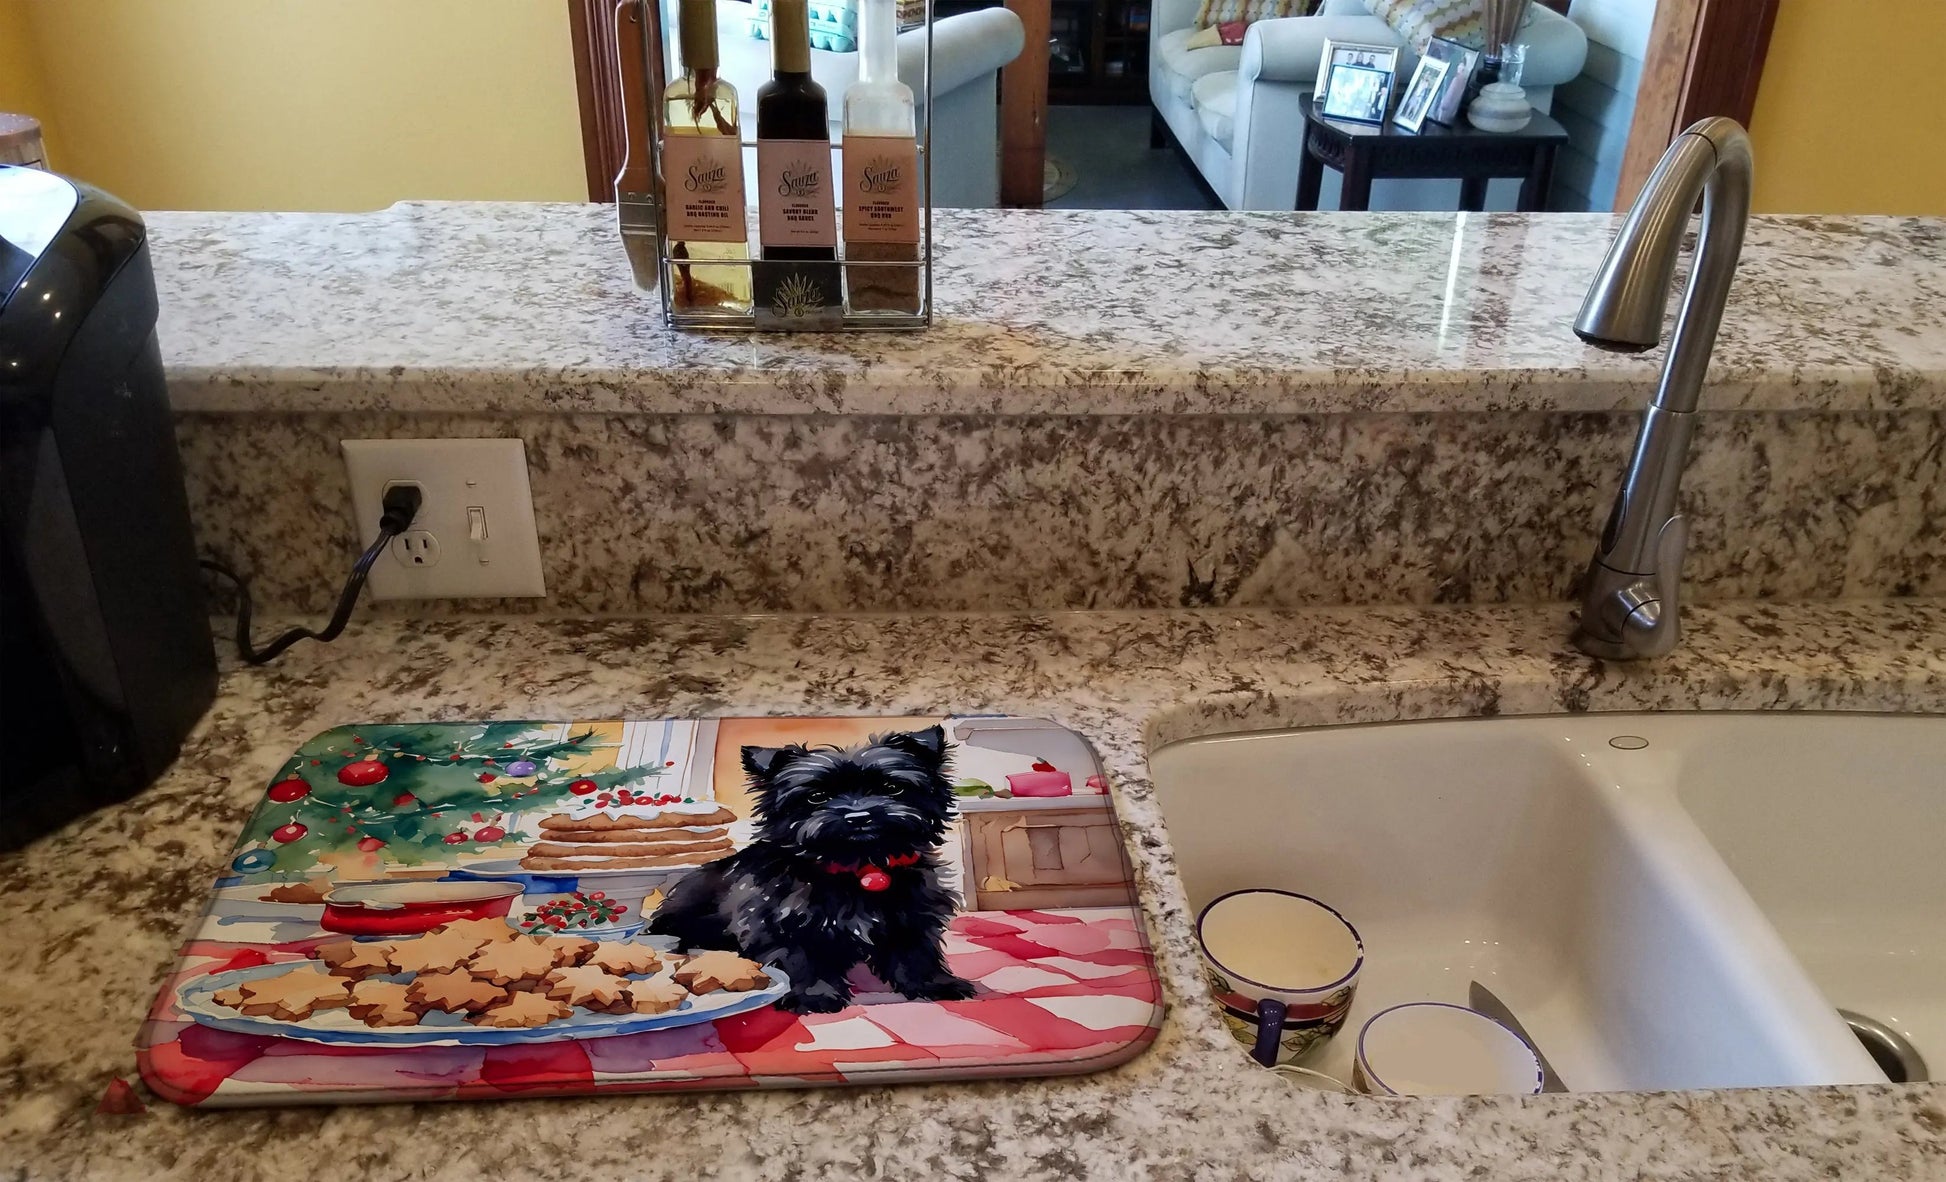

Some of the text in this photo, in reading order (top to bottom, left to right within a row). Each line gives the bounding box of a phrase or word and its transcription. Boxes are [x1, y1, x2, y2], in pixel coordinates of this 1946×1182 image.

[685, 166, 725, 191] Sauza
[778, 171, 819, 197] Sauza
[860, 167, 899, 192] Sauza
